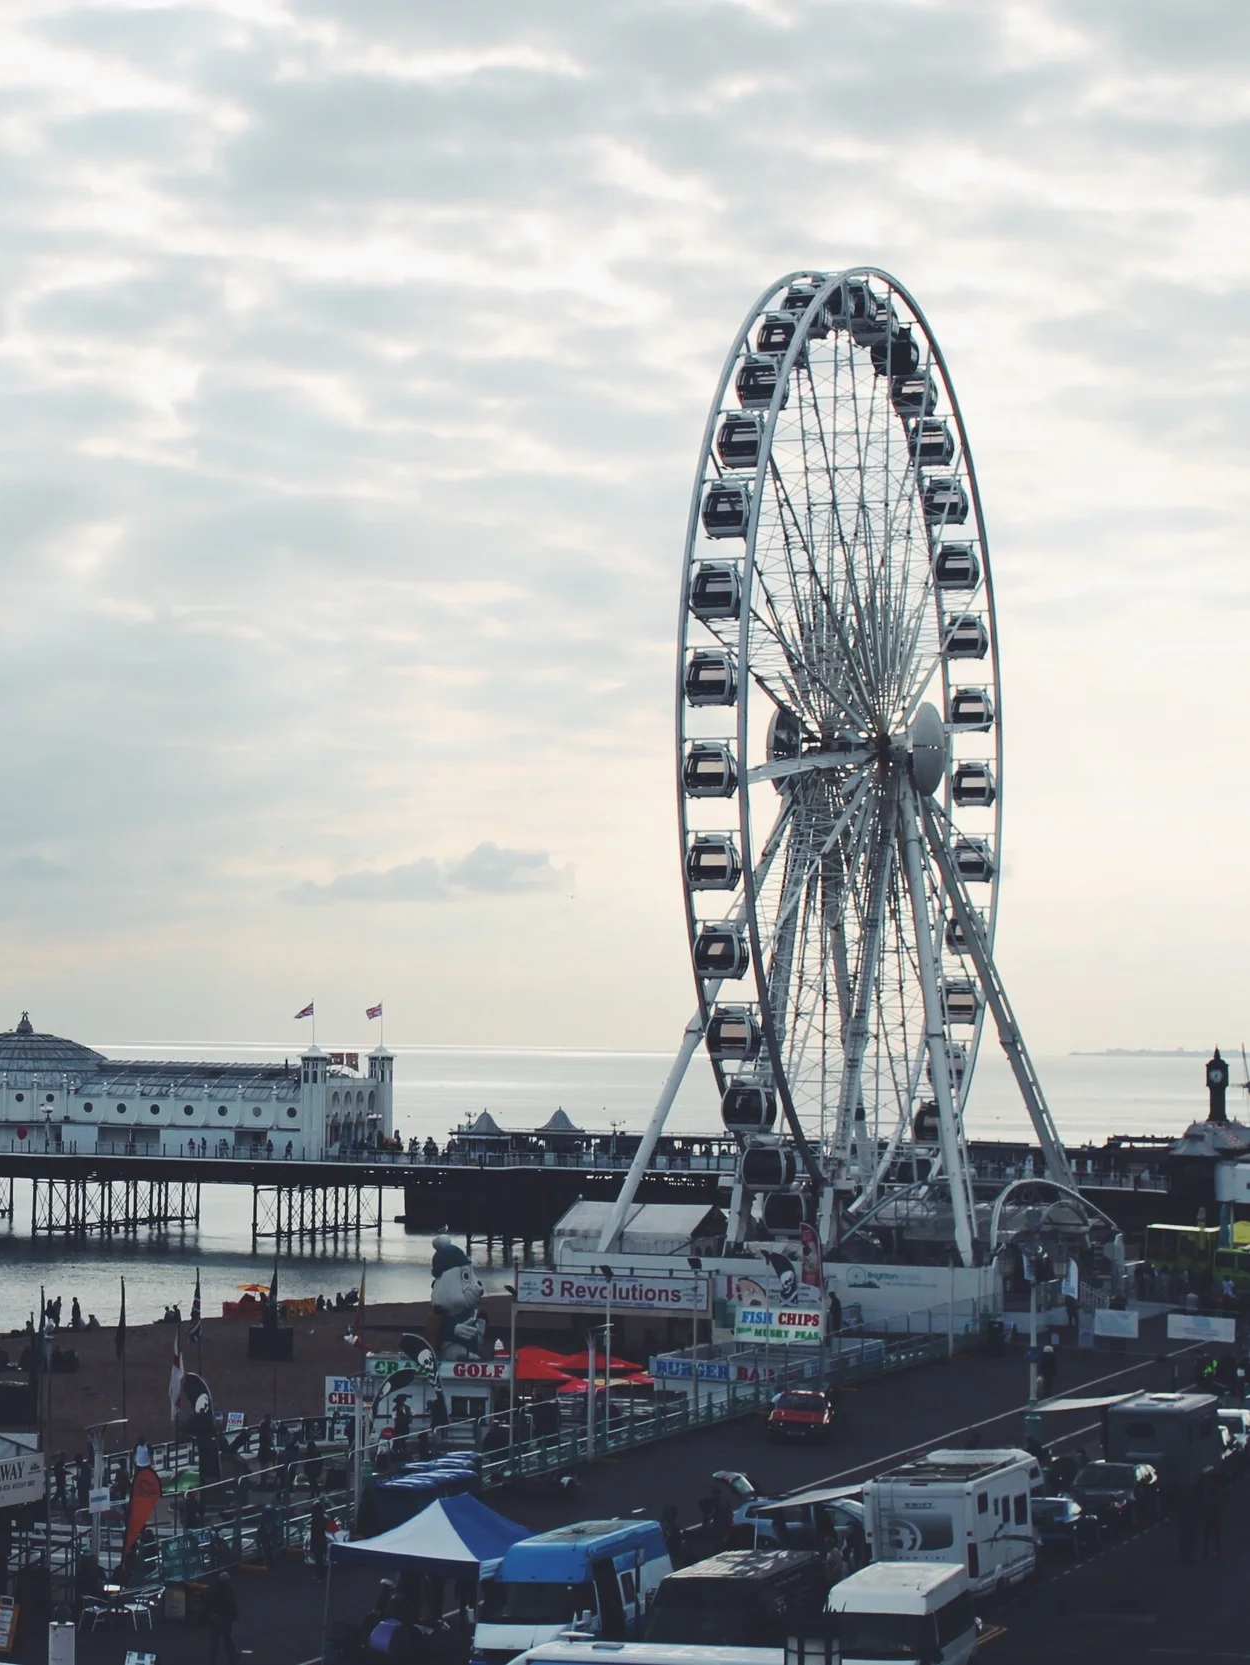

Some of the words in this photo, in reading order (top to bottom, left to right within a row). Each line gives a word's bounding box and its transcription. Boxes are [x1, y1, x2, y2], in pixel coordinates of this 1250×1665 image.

[541, 1277, 554, 1298] 3
[560, 1280, 682, 1303] Revolutions
[741, 1311, 773, 1325] FISH
[778, 1312, 820, 1327] CHIPS
[794, 1330, 819, 1339] PEAS
[453, 1363, 506, 1380] GOLF
[655, 1360, 730, 1380] BURGER
[736, 1365, 776, 1383] BAR
